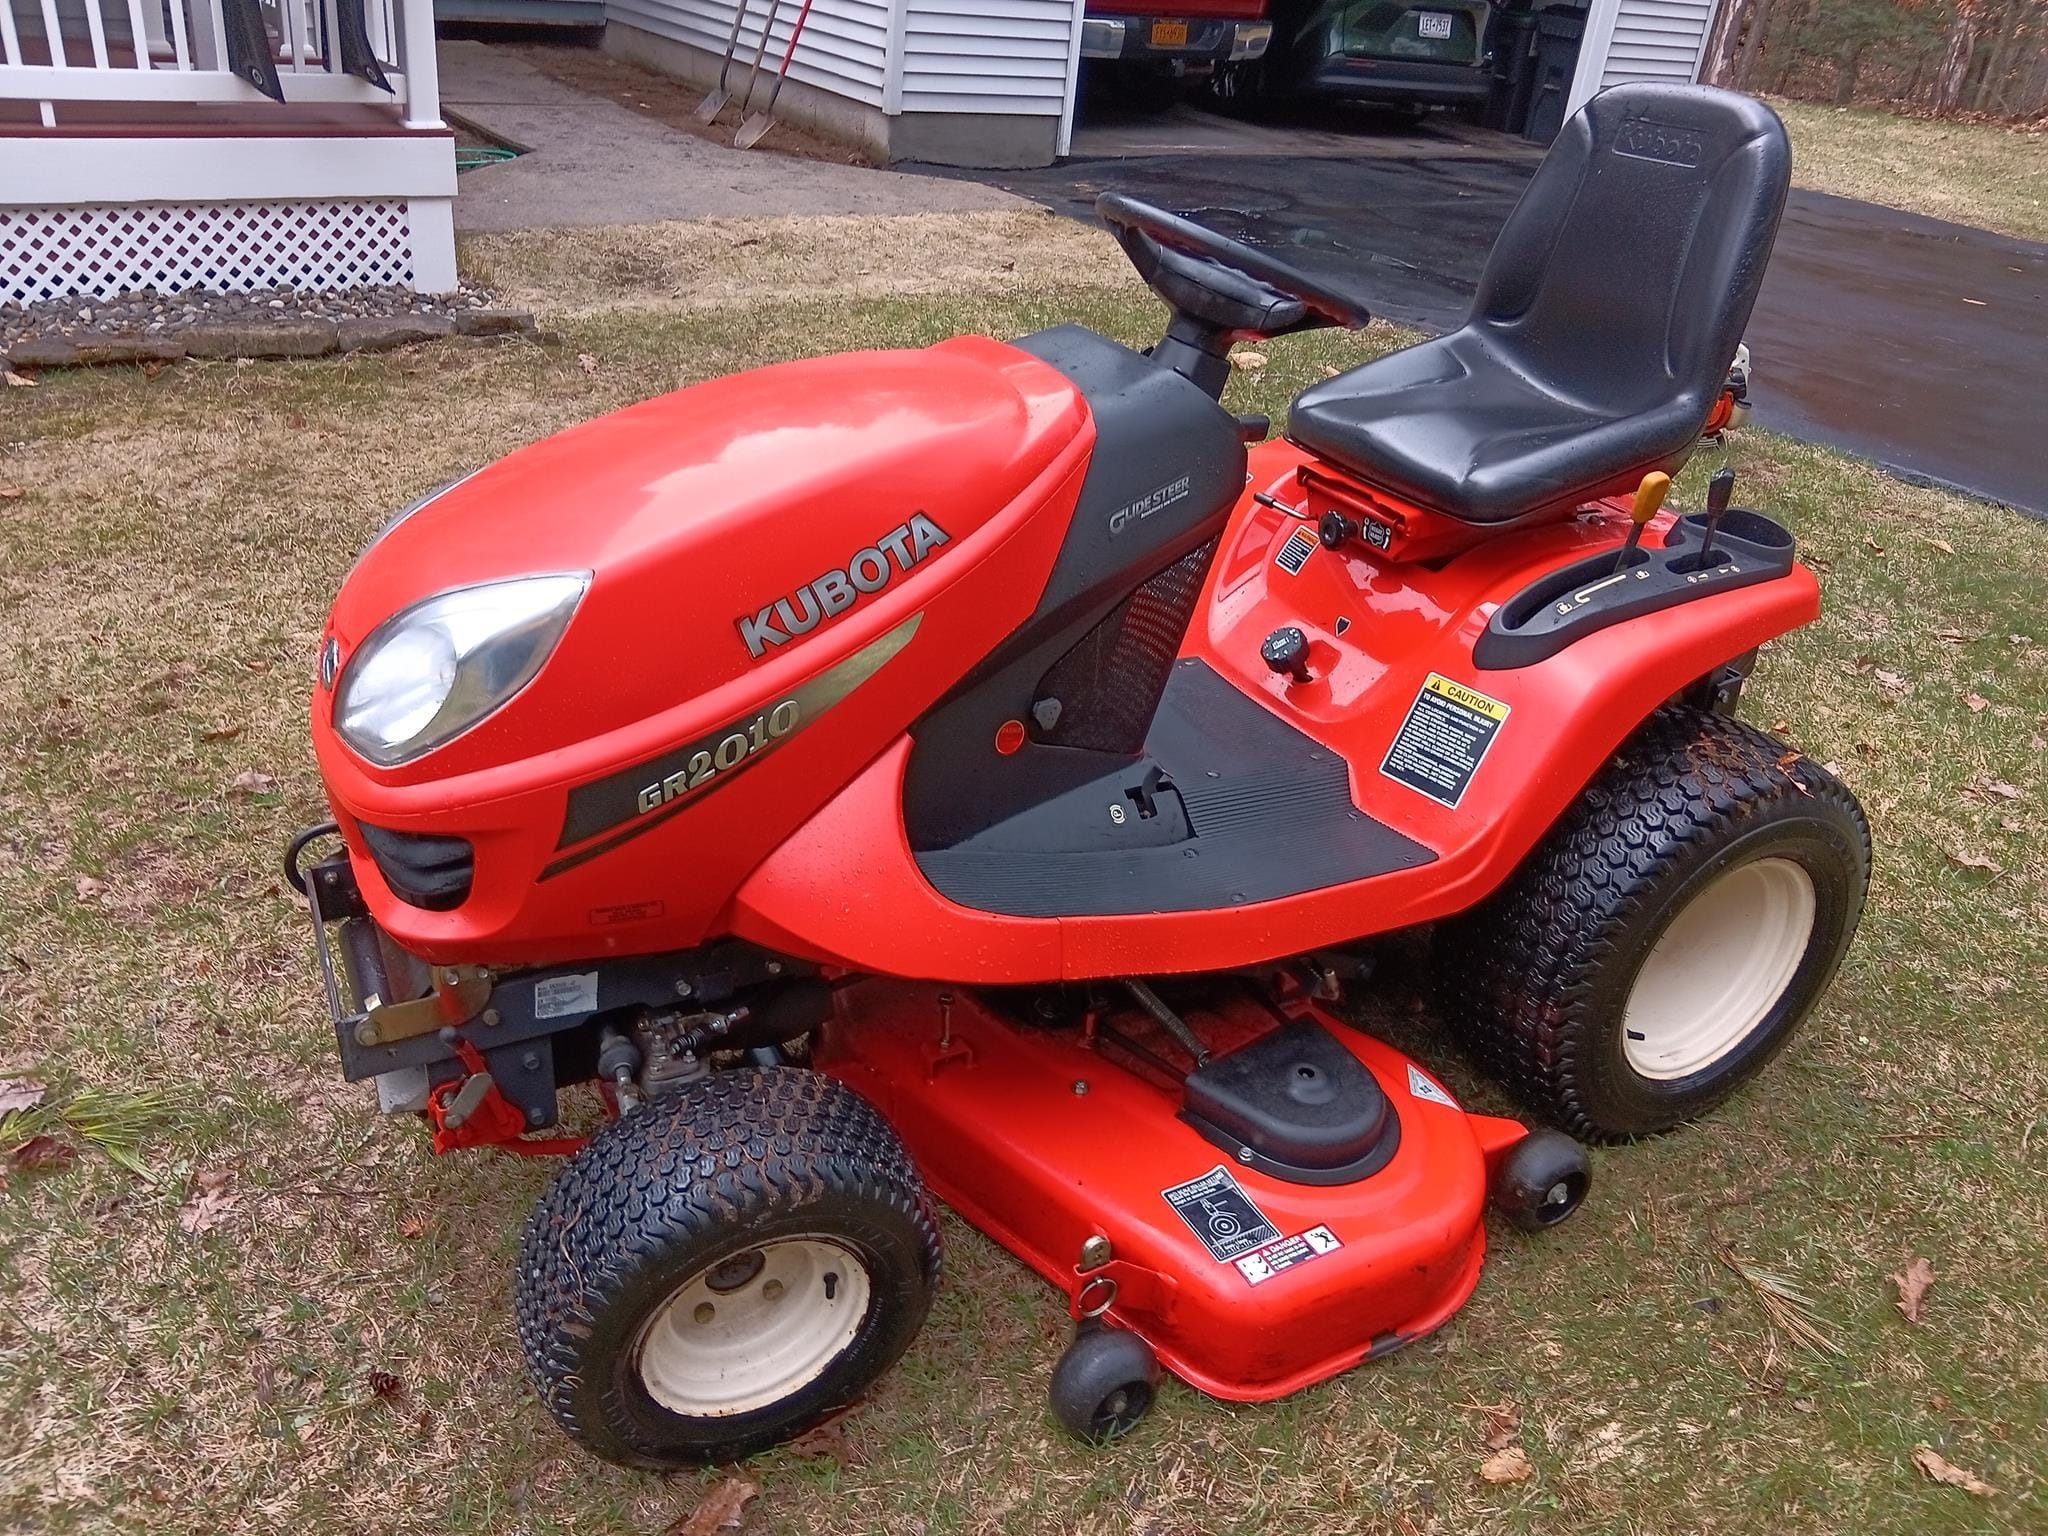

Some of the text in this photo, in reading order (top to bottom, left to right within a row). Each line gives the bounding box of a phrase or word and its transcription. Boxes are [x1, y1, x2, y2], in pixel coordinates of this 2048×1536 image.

[737, 510, 951, 659] KUBOTA
[1422, 692, 1431, 700] TO
[1429, 695, 1446, 707] AVOID
[1446, 685, 1494, 713] CAUTION
[638, 700, 801, 815] GR2010
